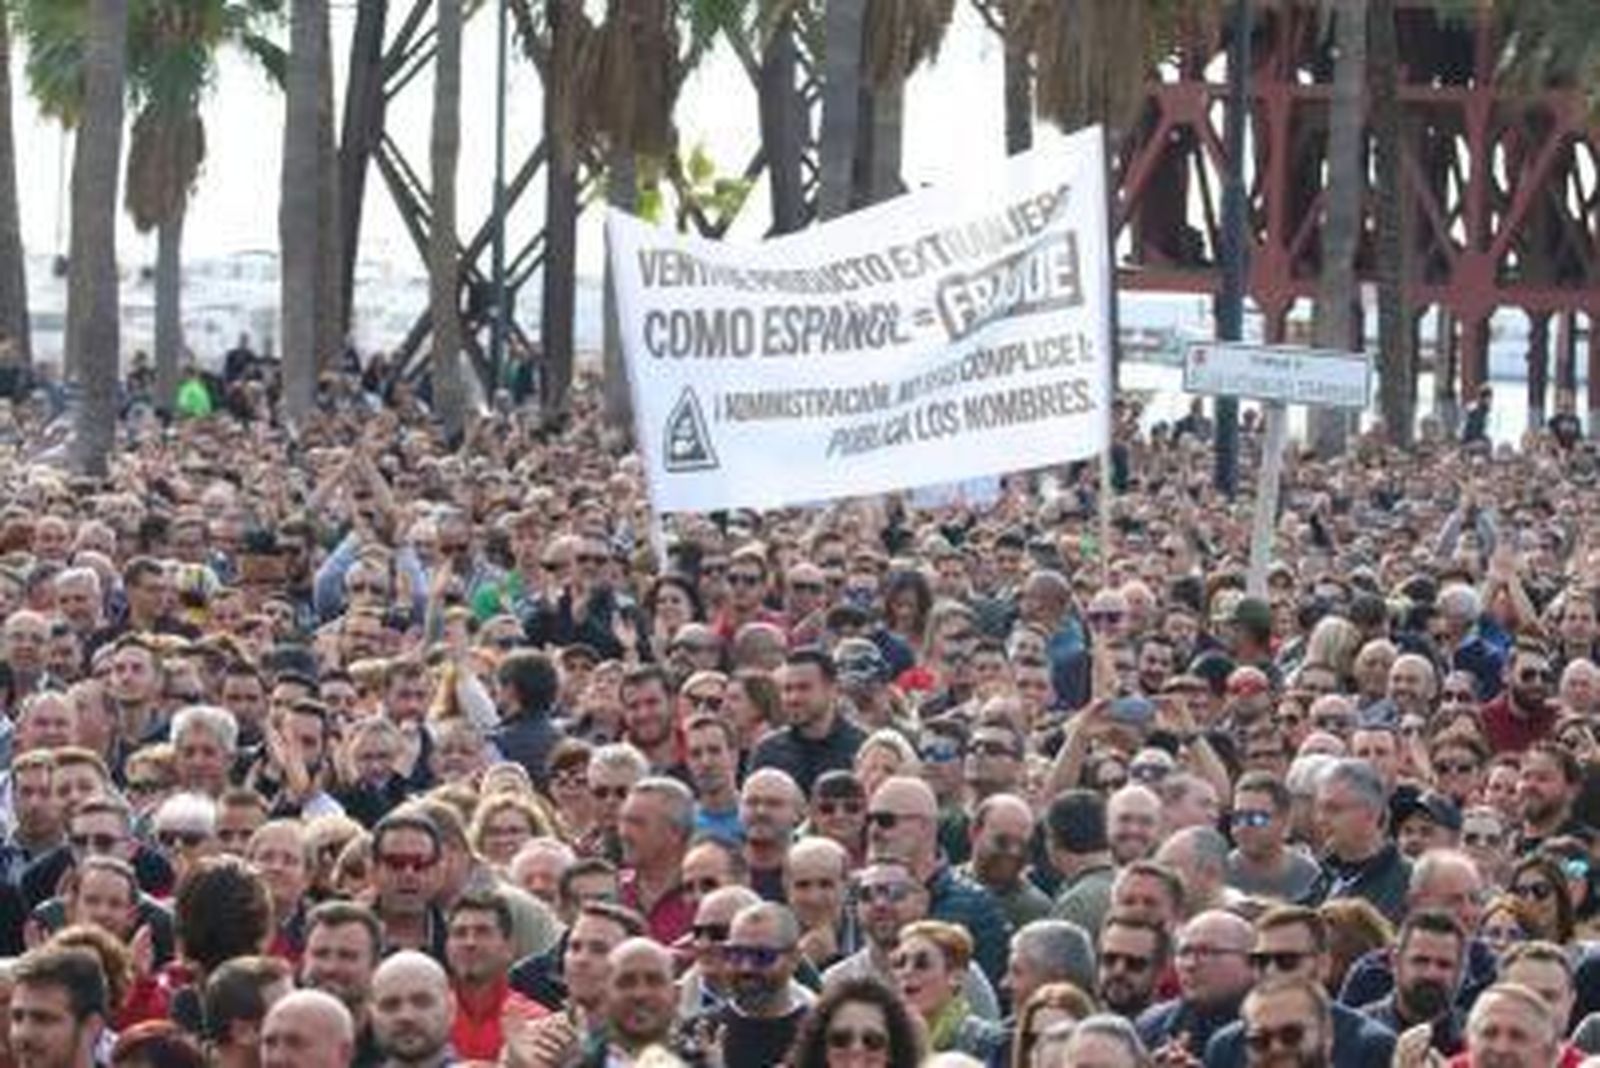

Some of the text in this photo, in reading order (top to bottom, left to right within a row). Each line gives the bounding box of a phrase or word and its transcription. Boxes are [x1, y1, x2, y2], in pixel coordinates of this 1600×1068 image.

[643, 309, 754, 358] COMO
[762, 301, 912, 357] ESPAÑOL
[914, 401, 961, 441] LOS
